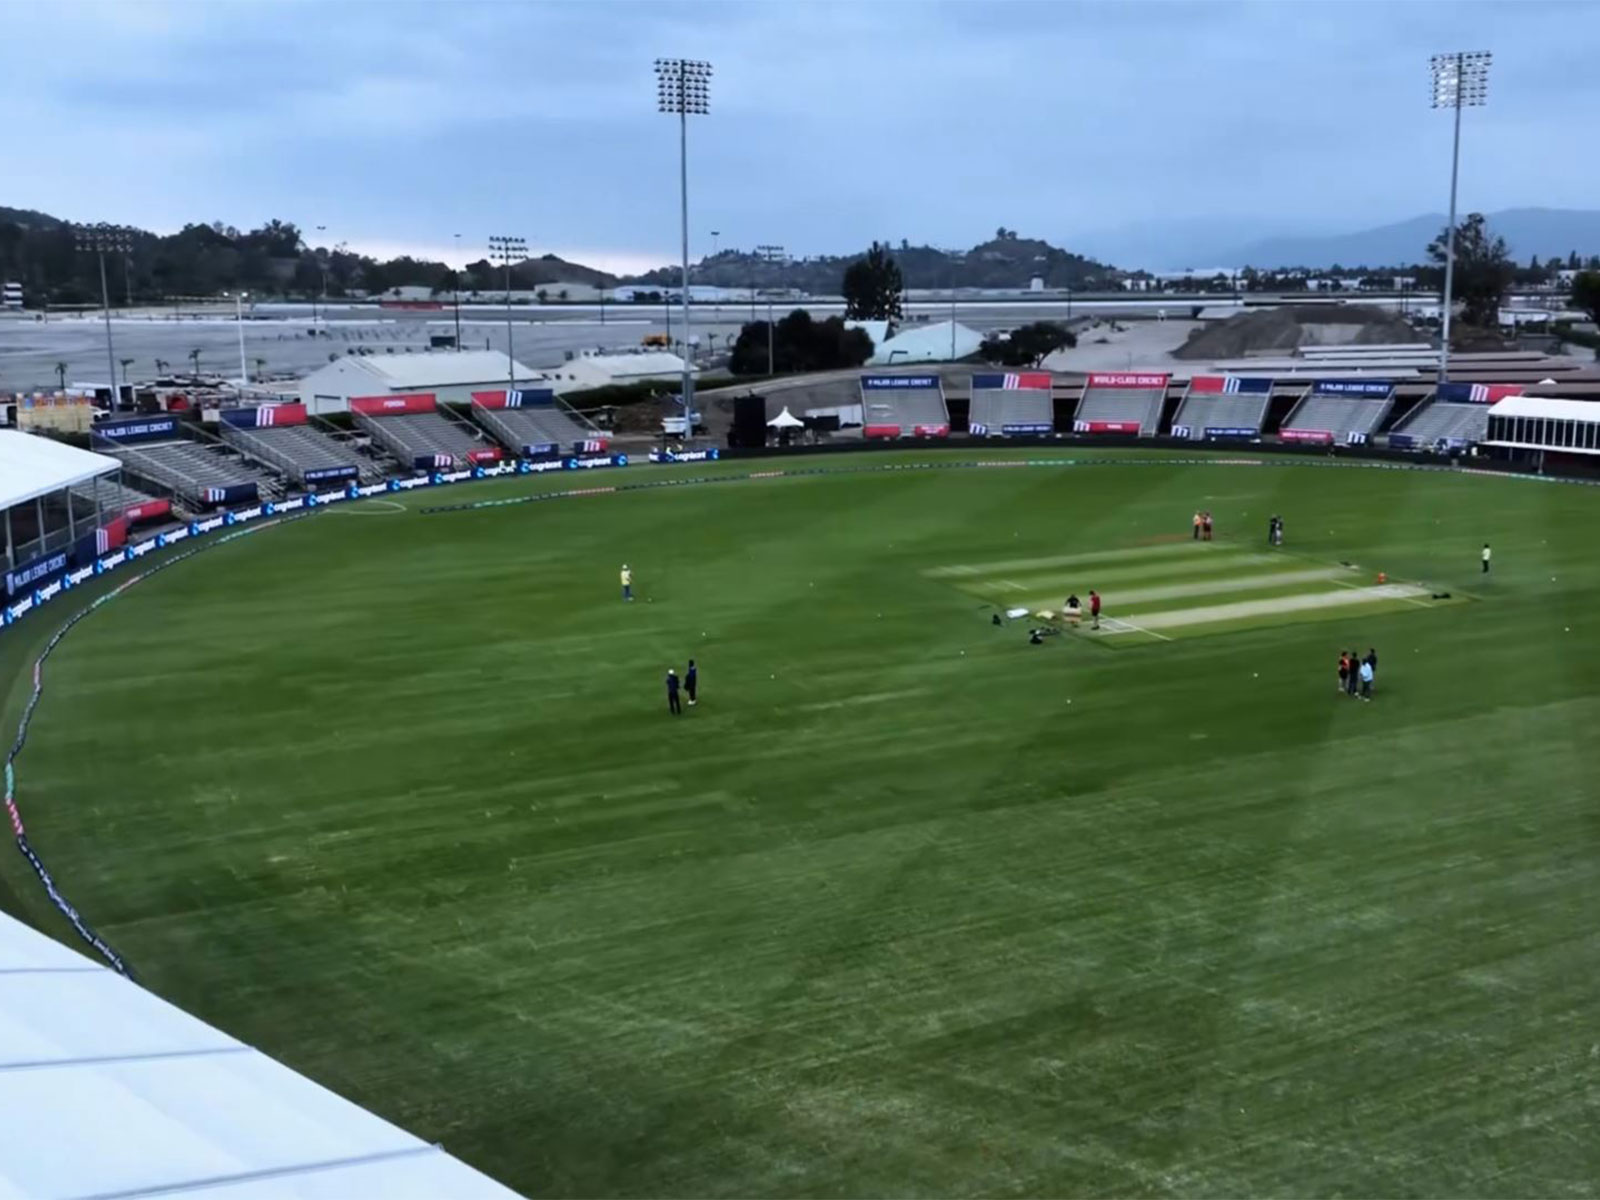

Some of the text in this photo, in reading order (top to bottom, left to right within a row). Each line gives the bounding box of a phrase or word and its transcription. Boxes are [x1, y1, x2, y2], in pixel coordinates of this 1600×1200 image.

[106, 422, 173, 437] MAJOR LEAGUE CRICKET
[14, 554, 66, 588] MAJOR LEAGUE CRICKET
